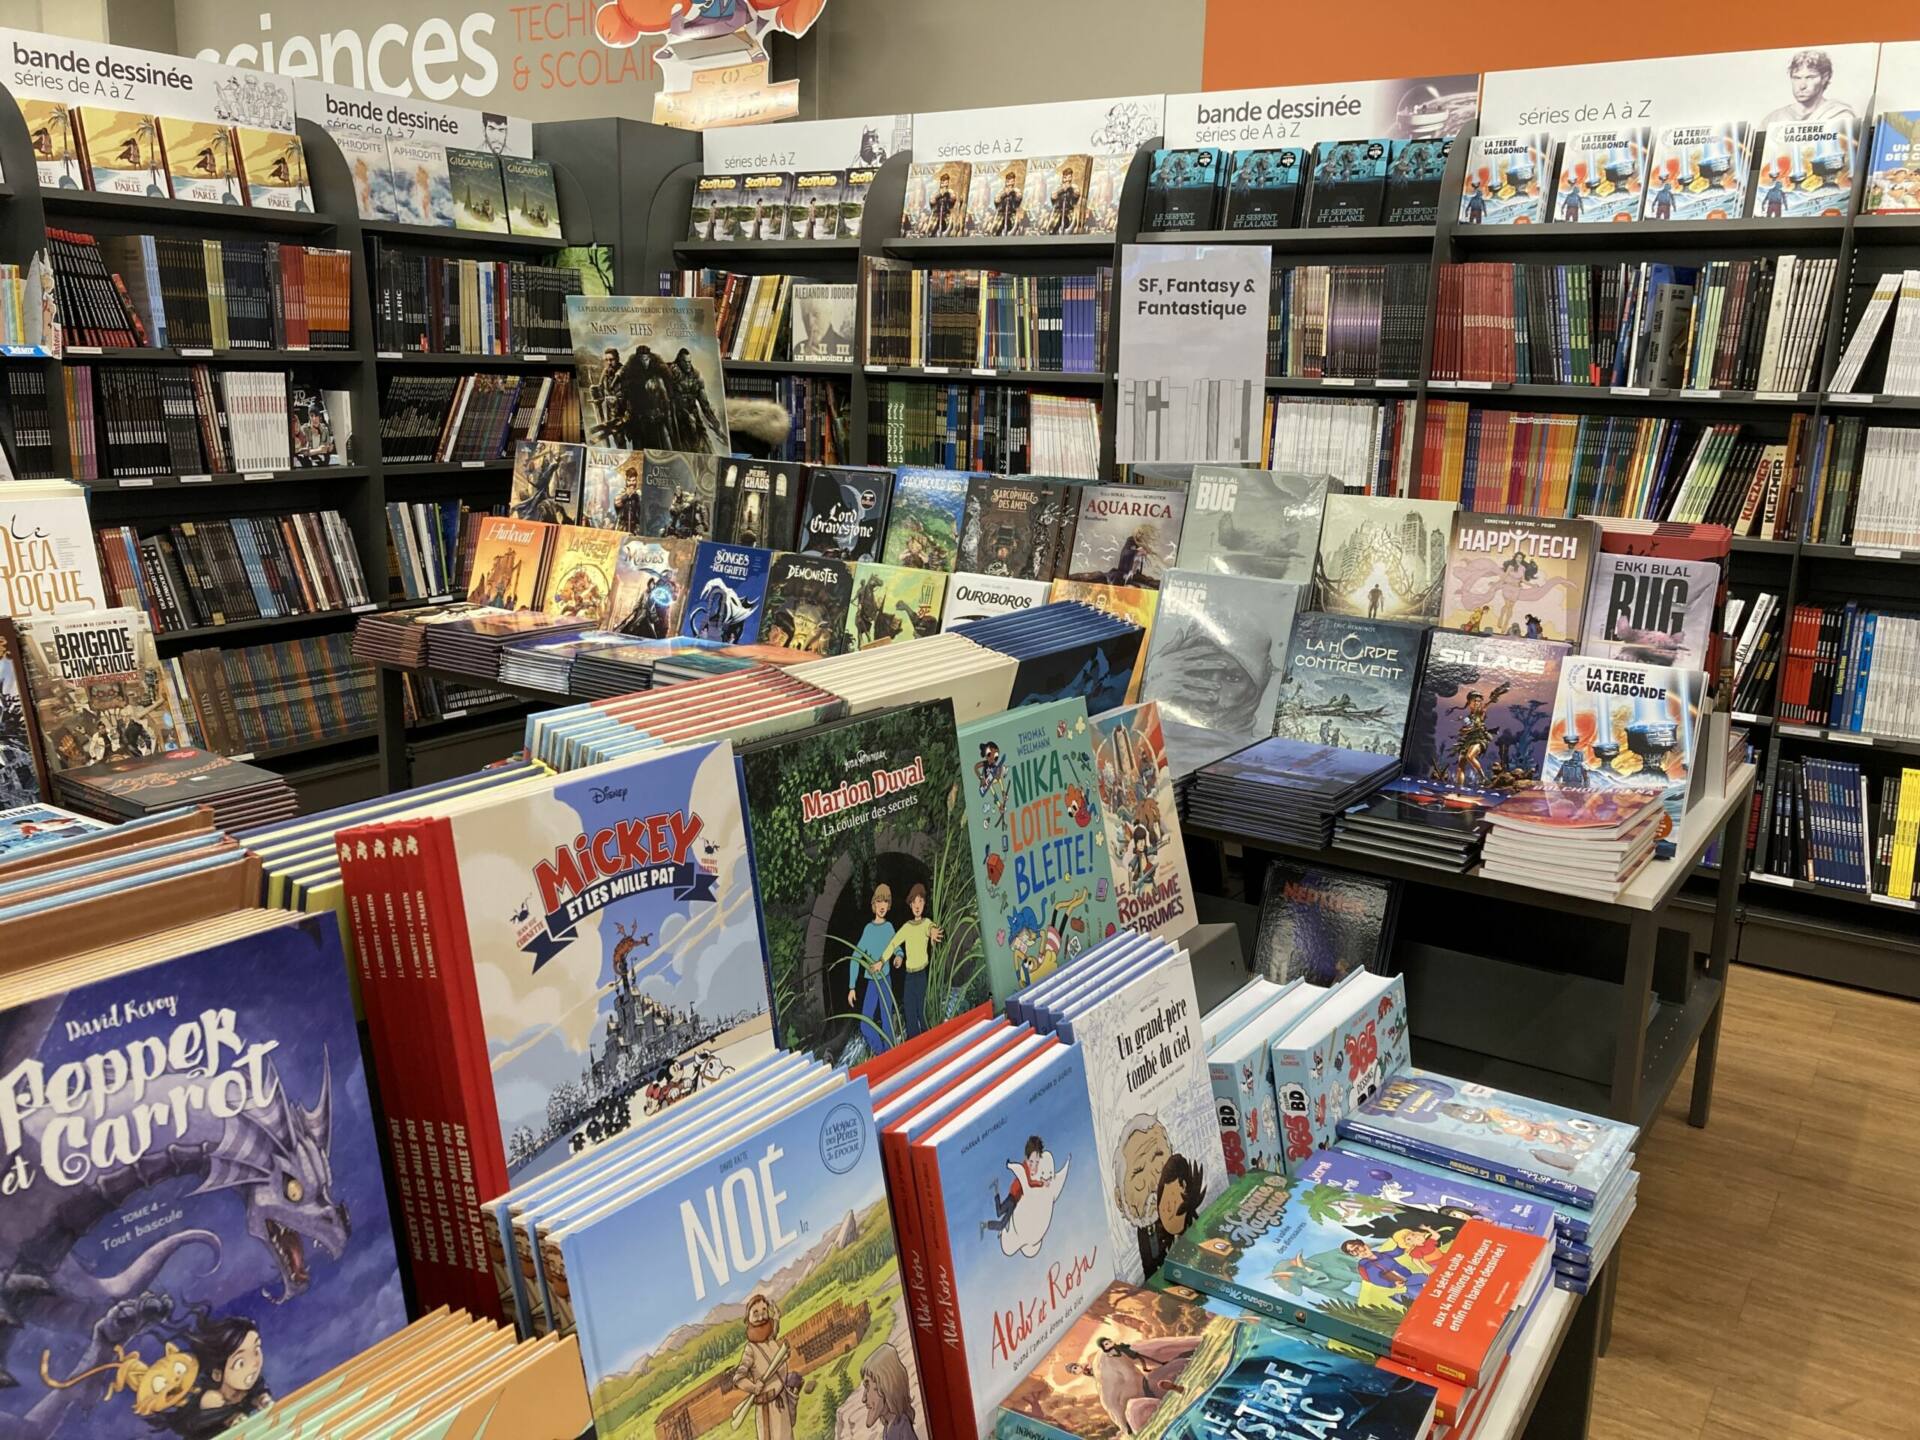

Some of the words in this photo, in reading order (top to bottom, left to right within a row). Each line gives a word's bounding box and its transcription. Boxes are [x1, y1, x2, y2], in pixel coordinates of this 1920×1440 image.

[12, 41, 90, 74] bande
[95, 56, 193, 91] dessinée
[513, 56, 530, 91] &
[14, 69, 63, 91] séries
[68, 79, 89, 94] de
[94, 80, 106, 97] A
[110, 81, 120, 98] à
[124, 84, 136, 100] Z
[326, 93, 384, 123] bande
[387, 105, 459, 135] dessinée
[1197, 103, 1262, 125] bande
[1267, 95, 1362, 120] dessinée
[1518, 103, 1571, 126] séries
[1574, 103, 1599, 122] de
[1603, 101, 1617, 121] A
[1621, 100, 1633, 119] à
[1638, 99, 1652, 119] Z
[1195, 122, 1237, 143] séries
[1240, 123, 1258, 140] de
[1263, 123, 1274, 139] A
[1278, 122, 1287, 139] à
[1289, 121, 1301, 138] Z
[1784, 133, 1838, 142] VAGABONDE
[1785, 125, 1795, 134] LA
[1797, 125, 1824, 134] TERRE
[938, 142, 971, 158] séries
[973, 141, 991, 155] de
[992, 140, 1002, 154] A
[1003, 137, 1012, 154] à
[1014, 138, 1024, 153] Z
[1484, 146, 1529, 156] VAGABONDE
[1581, 141, 1629, 151] VAGABONDE
[724, 153, 752, 168] séries
[754, 153, 768, 167] de
[770, 152, 778, 166] A
[780, 150, 787, 165] à
[788, 151, 796, 165] Z
[115, 181, 143, 194] PARLE
[192, 188, 219, 200] PARLE
[1138, 278, 1162, 296] SF,
[1167, 278, 1240, 298] Fantasy
[1243, 278, 1256, 293] &
[384, 289, 392, 321] ELRIC
[396, 290, 404, 322] ELRIC
[1138, 300, 1247, 320] Fantastique
[744, 476, 770, 490] CHAOS
[1085, 498, 1172, 520] AQUARICA
[1195, 482, 1239, 513] BUG
[829, 502, 858, 522] Lord
[11, 513, 51, 540] Le
[810, 515, 874, 538] Gravestone
[714, 549, 750, 567] SONGES
[1615, 560, 1649, 575] ENKI
[1651, 562, 1692, 579] BILAL
[955, 584, 1032, 609] OUROBOROS
[54, 627, 135, 660] BRIGADE
[1306, 638, 1325, 652] LA
[1329, 631, 1399, 662] HORDE
[1294, 654, 1404, 680] CONTREVENT
[1585, 680, 1667, 701] VAGABONDE
[1017, 725, 1046, 744] THOMAS
[1016, 737, 1052, 758] WELLMANN
[801, 772, 871, 824] Marion
[873, 755, 927, 797] Duval
[1009, 747, 1068, 807] NIKA,
[588, 785, 628, 806] Disney
[822, 820, 835, 837] La
[836, 808, 871, 834] couleur
[871, 804, 887, 820] des
[887, 793, 919, 816] secrets
[565, 898, 585, 921] ET
[585, 885, 610, 912] LES
[609, 873, 649, 899] MILLE
[650, 866, 676, 887] PAT
[1115, 882, 1127, 897] LE
[1116, 872, 1182, 924] ROYAUME
[66, 1003, 125, 1042] David
[123, 992, 179, 1027] Revoy
[1116, 1032, 1134, 1061] Un
[1134, 998, 1187, 1055] grand-père
[1126, 1049, 1158, 1093] tombé
[1159, 1042, 1173, 1069] du
[1173, 1024, 1191, 1059] ciel
[1344, 1019, 1378, 1083] 365
[1289, 1090, 1306, 1112] BD
[2, 1153, 37, 1197] et
[41, 1038, 281, 1188] Carrot
[832, 1117, 858, 1133] VOYAGE
[1219, 1105, 1237, 1127] BD
[405, 1117, 418, 1141] PAT
[1283, 1114, 1314, 1162] 365
[410, 1141, 425, 1177] MILLE
[416, 1176, 429, 1199] LES
[121, 1203, 150, 1226] TOME
[150, 1201, 160, 1214] 4
[420, 1199, 431, 1215] ET
[1230, 1190, 1287, 1248] Magique
[101, 1231, 132, 1252] Tout
[135, 1208, 185, 1240] bascule
[679, 1142, 799, 1302] NOÉ
[1468, 1238, 1493, 1267] lecteurs
[1479, 1247, 1506, 1278] dessinée
[1429, 1288, 1442, 1299] La
[1436, 1271, 1454, 1290] série
[1448, 1252, 1466, 1271] culte
[1462, 1265, 1477, 1276] de
[1446, 1273, 1471, 1304] millions
[1464, 1276, 1488, 1301] bande
[991, 1296, 1037, 1369] Aldo
[1038, 1299, 1047, 1326] et
[1047, 1245, 1098, 1310] Rosa
[1440, 1302, 1453, 1312] 14
[1462, 1299, 1475, 1311] en
[1432, 1311, 1448, 1328] aux
[1449, 1309, 1468, 1332] enfin
[1203, 1411, 1232, 1436] LE
